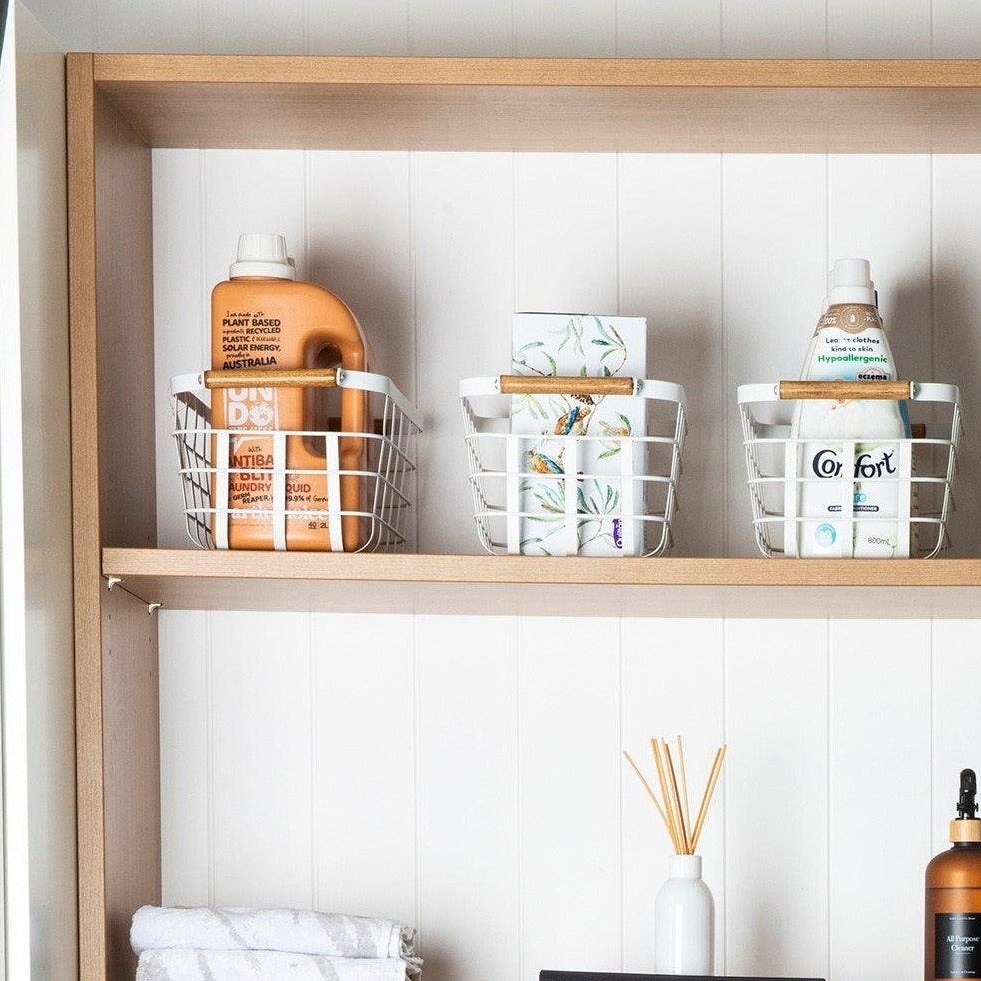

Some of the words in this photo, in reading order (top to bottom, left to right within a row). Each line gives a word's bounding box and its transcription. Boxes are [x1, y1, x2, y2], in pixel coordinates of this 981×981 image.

[222, 318, 250, 327] PLANT
[251, 318, 281, 327] BASED
[246, 327, 281, 335] RECYCLED
[222, 335, 250, 343] PLASTIC
[852, 336, 880, 344] clothes
[222, 343, 249, 352] SOLAR
[249, 343, 281, 352] ENERGY,
[817, 353, 888, 363] Hypoallergenic
[222, 356, 277, 370] AUSTRALIA
[229, 454, 274, 467] NTIBA
[229, 482, 272, 492] AUNDRY
[286, 483, 311, 494] QUID
[946, 935, 955, 943] All
[955, 935, 980, 944] Purpose
[950, 944, 975, 952] Cleaner
